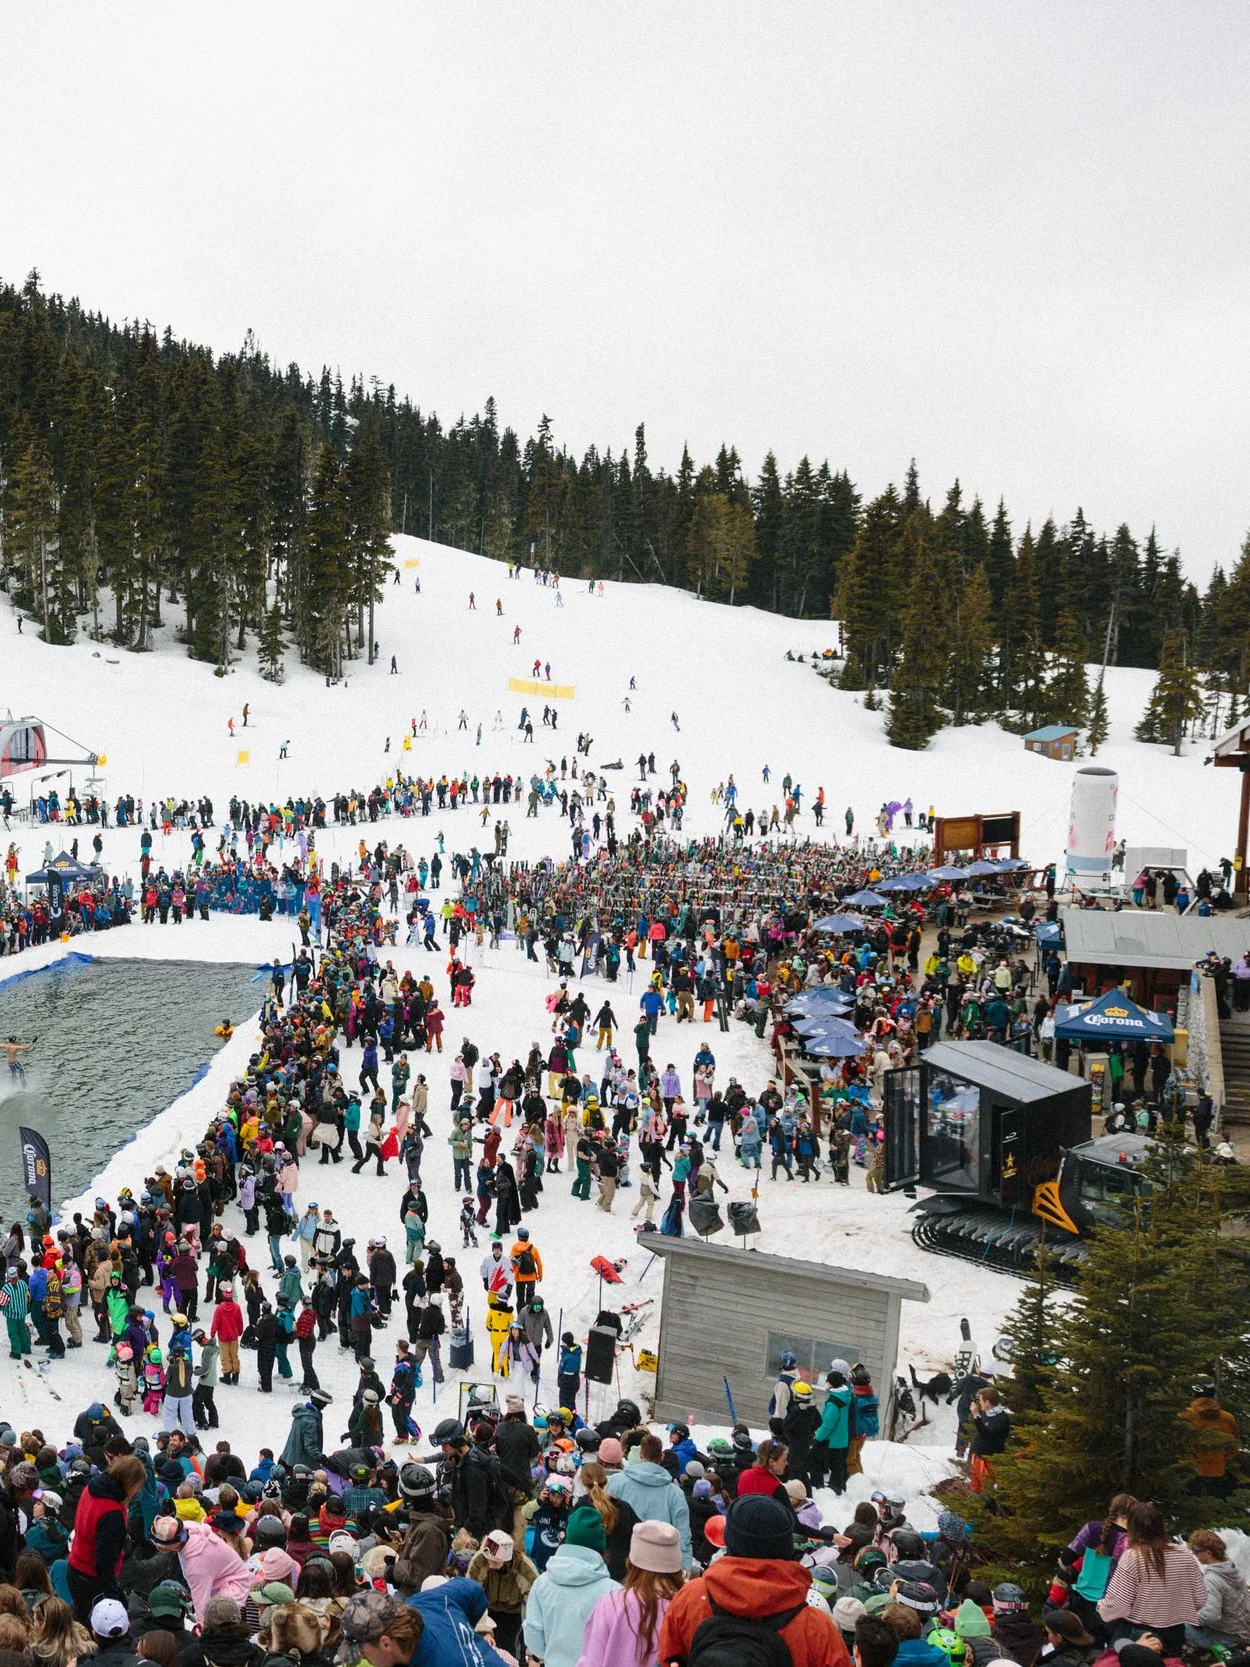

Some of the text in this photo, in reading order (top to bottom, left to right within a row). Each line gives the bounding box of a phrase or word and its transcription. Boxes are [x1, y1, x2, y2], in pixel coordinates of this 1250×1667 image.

[587, 942, 598, 969] Corona
[1083, 1013, 1146, 1028] Corona
[23, 1143, 37, 1185] Corona
